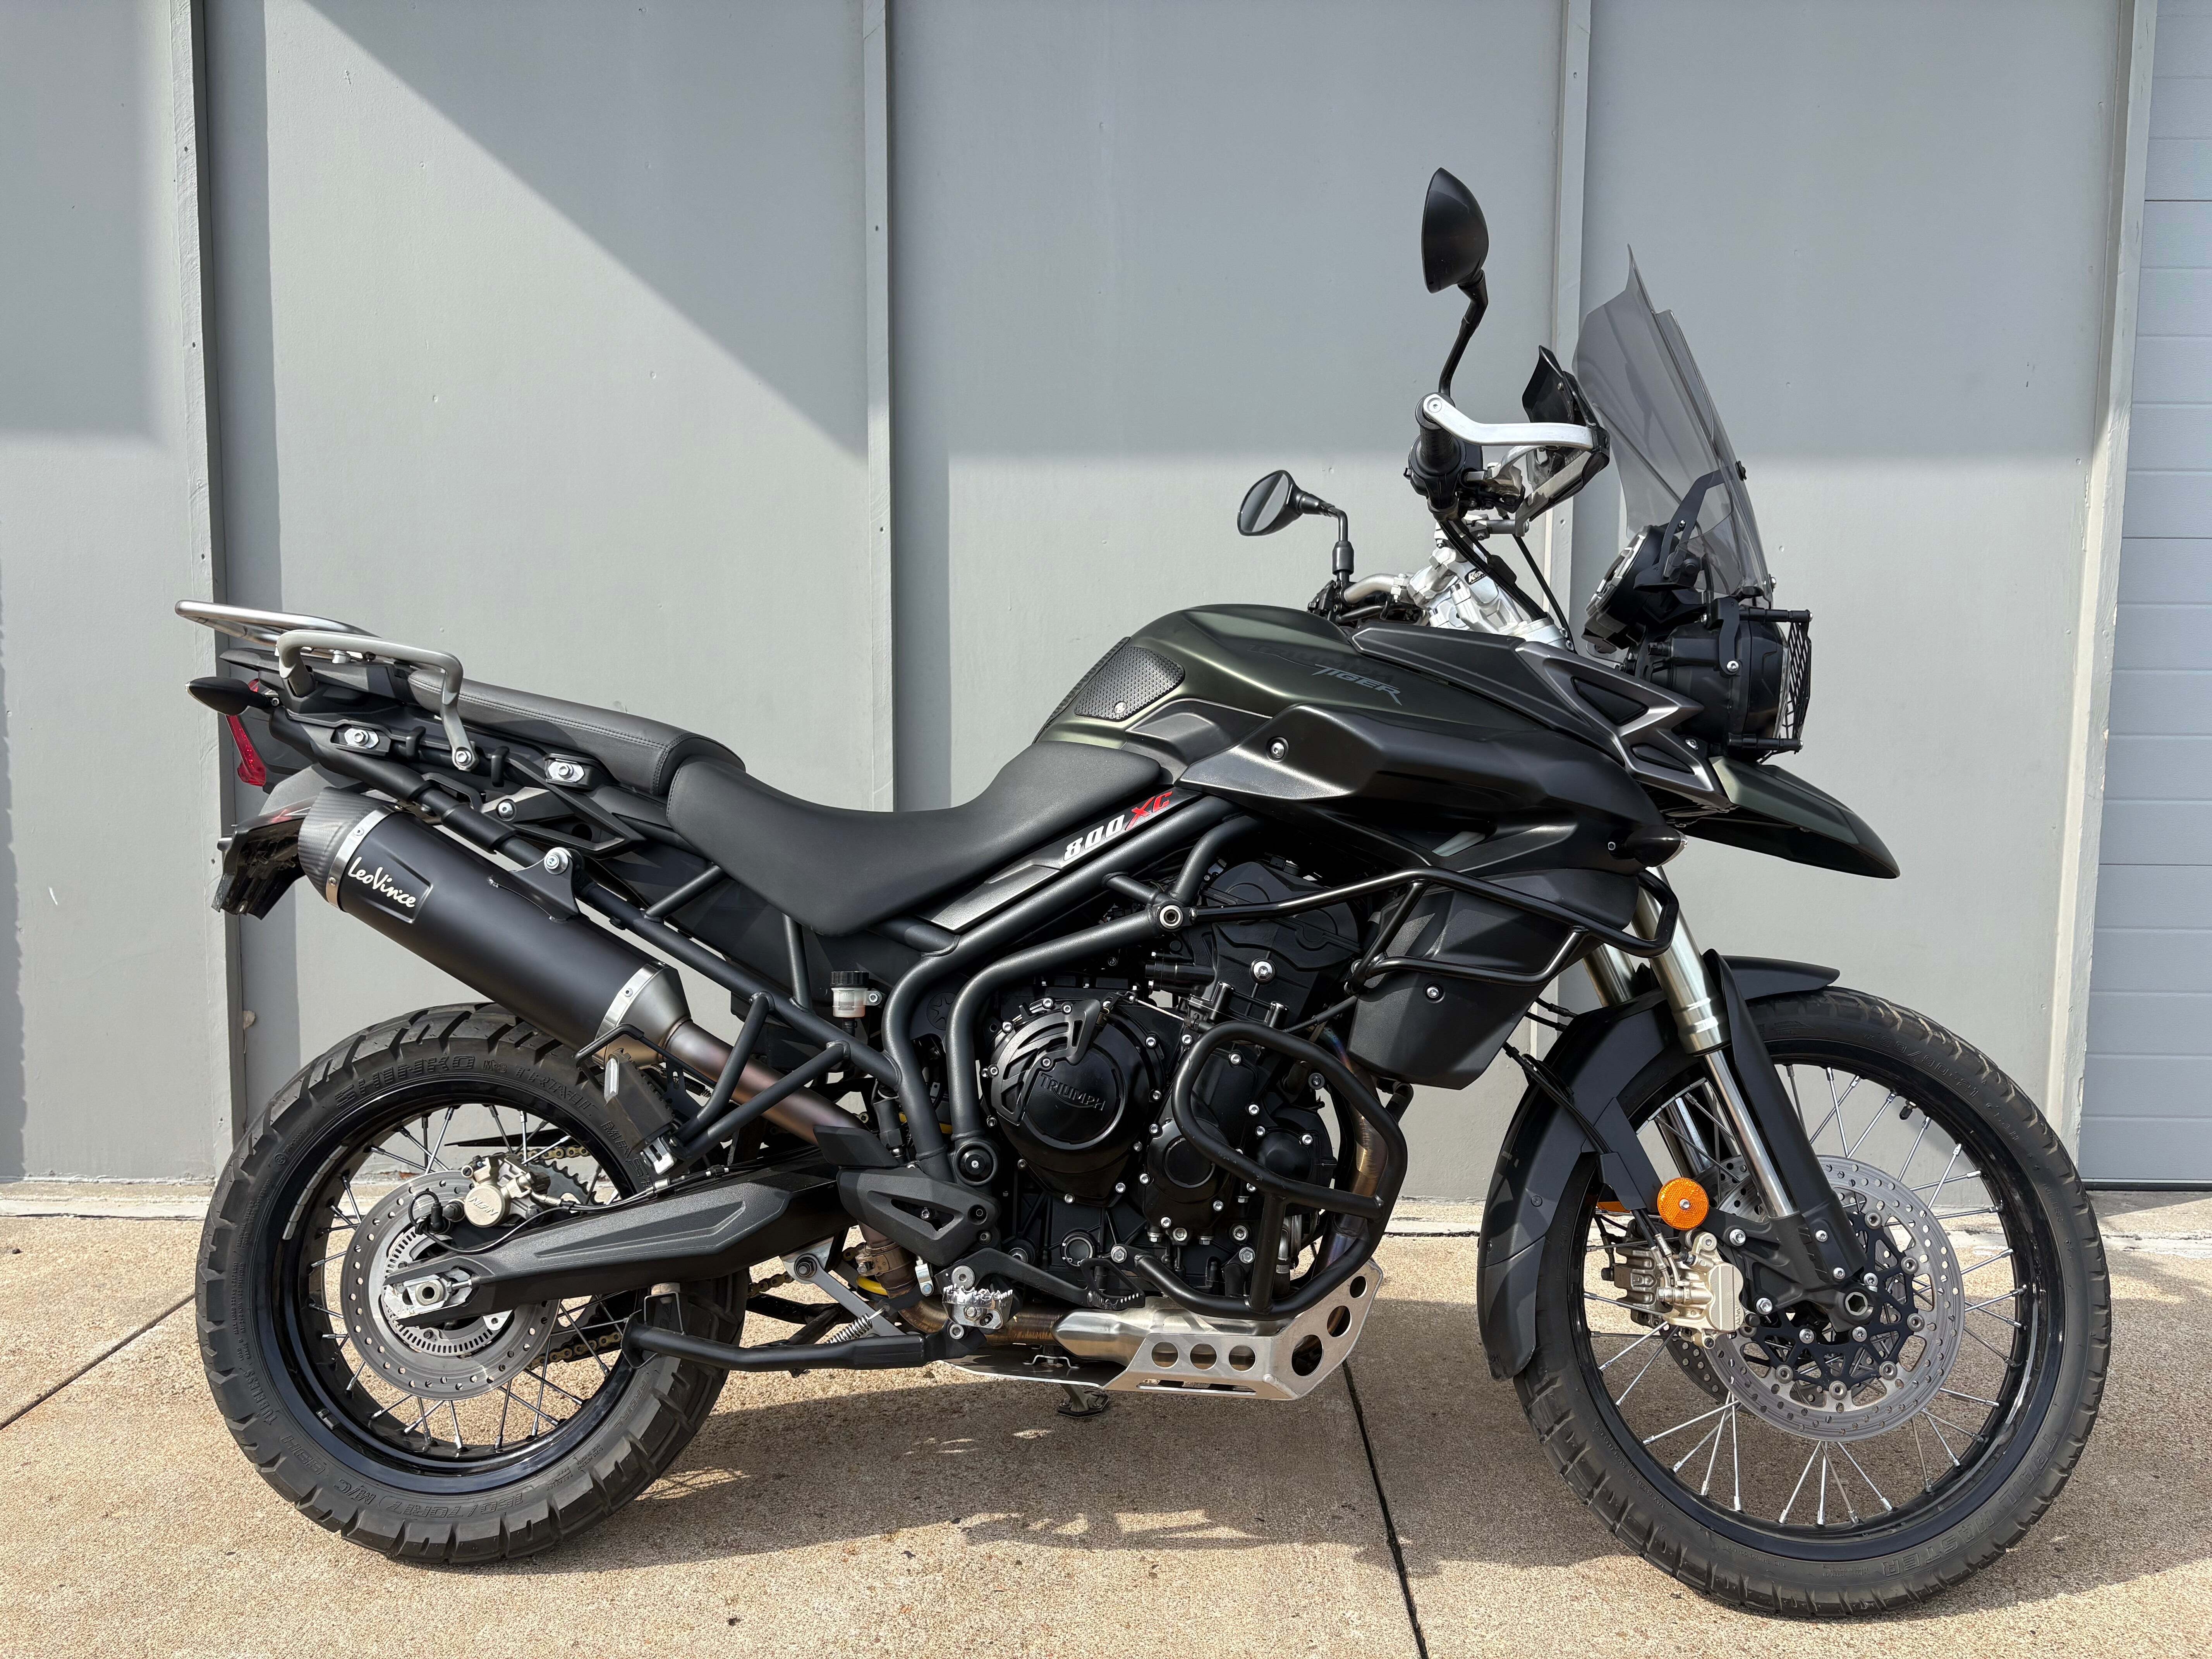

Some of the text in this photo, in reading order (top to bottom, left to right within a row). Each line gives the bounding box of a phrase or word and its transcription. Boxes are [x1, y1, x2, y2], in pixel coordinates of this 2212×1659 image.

[1312, 664, 1402, 706] TIGER
[1063, 791, 1173, 861] 800 XC
[348, 857, 416, 908] LeoVince
[334, 1055, 476, 1109] SHINKO
[1040, 1073, 1106, 1111] TRIUMPH
[244, 1369, 277, 1425] TUBELESS
[333, 1478, 376, 1505] M/C
[386, 1492, 522, 1517] 150/70R17
[1883, 1434, 2059, 1577] TRAIL MASTER
